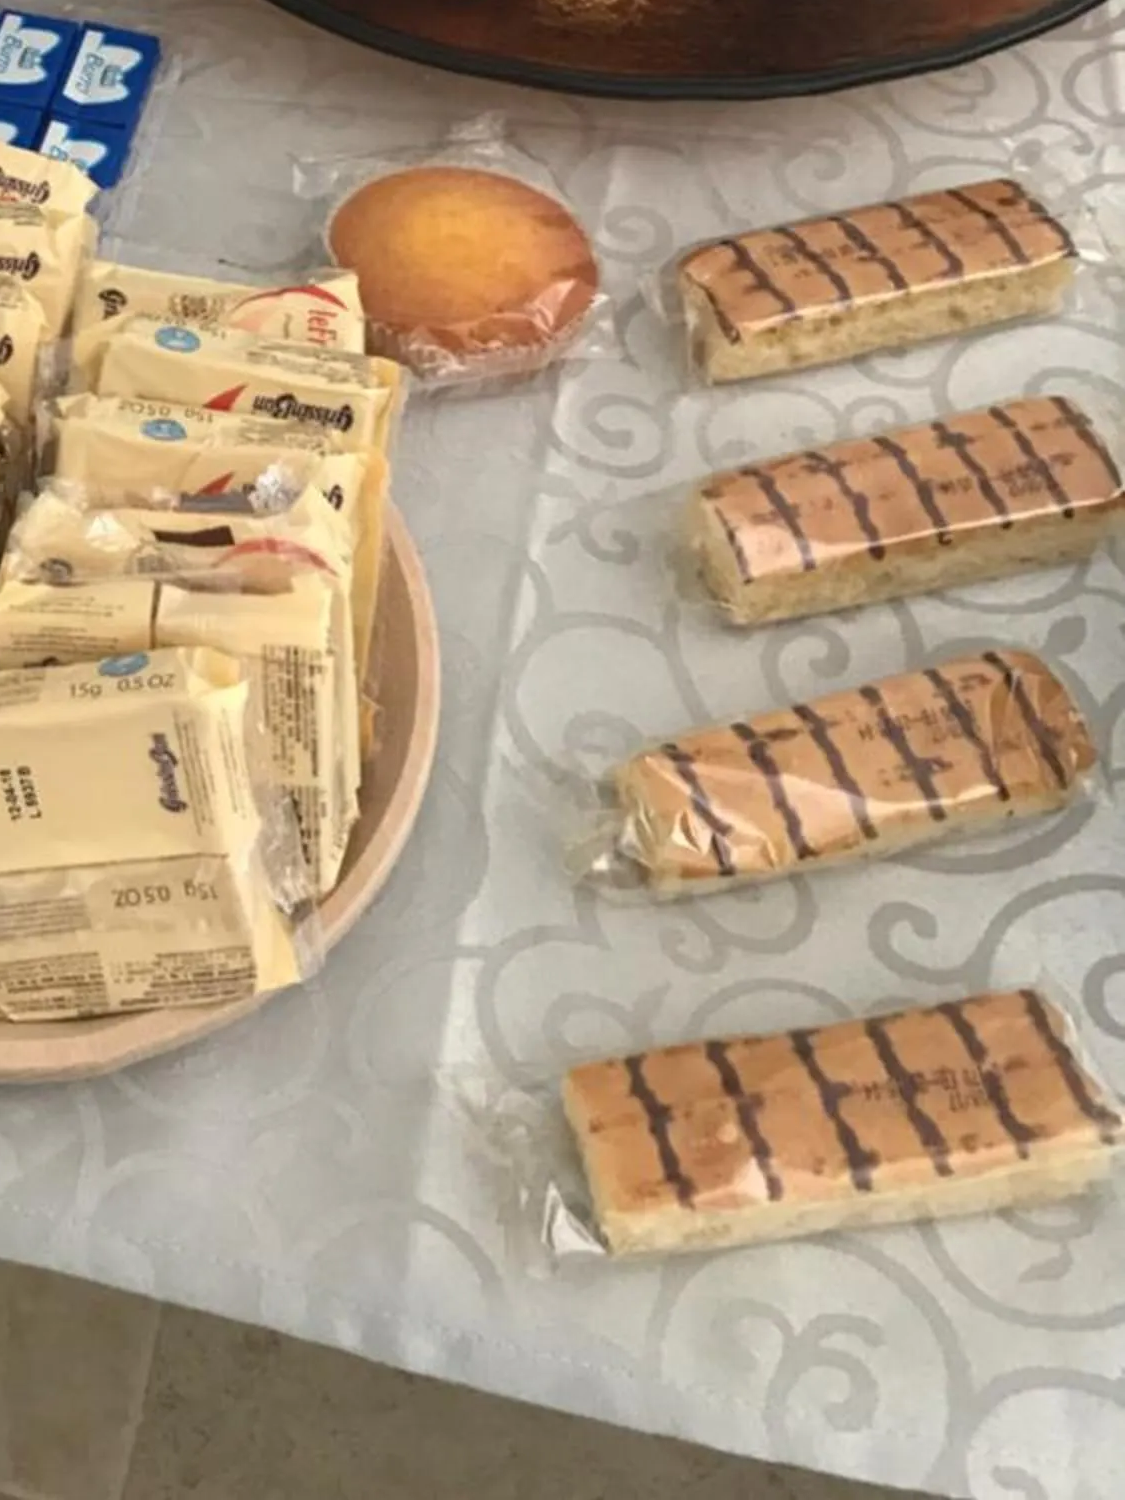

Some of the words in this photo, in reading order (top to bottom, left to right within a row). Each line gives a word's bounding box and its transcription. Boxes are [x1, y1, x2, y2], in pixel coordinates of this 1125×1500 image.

[75, 51, 104, 97] Burro
[69, 682, 102, 699] 15g
[183, 879, 219, 901] 15g
